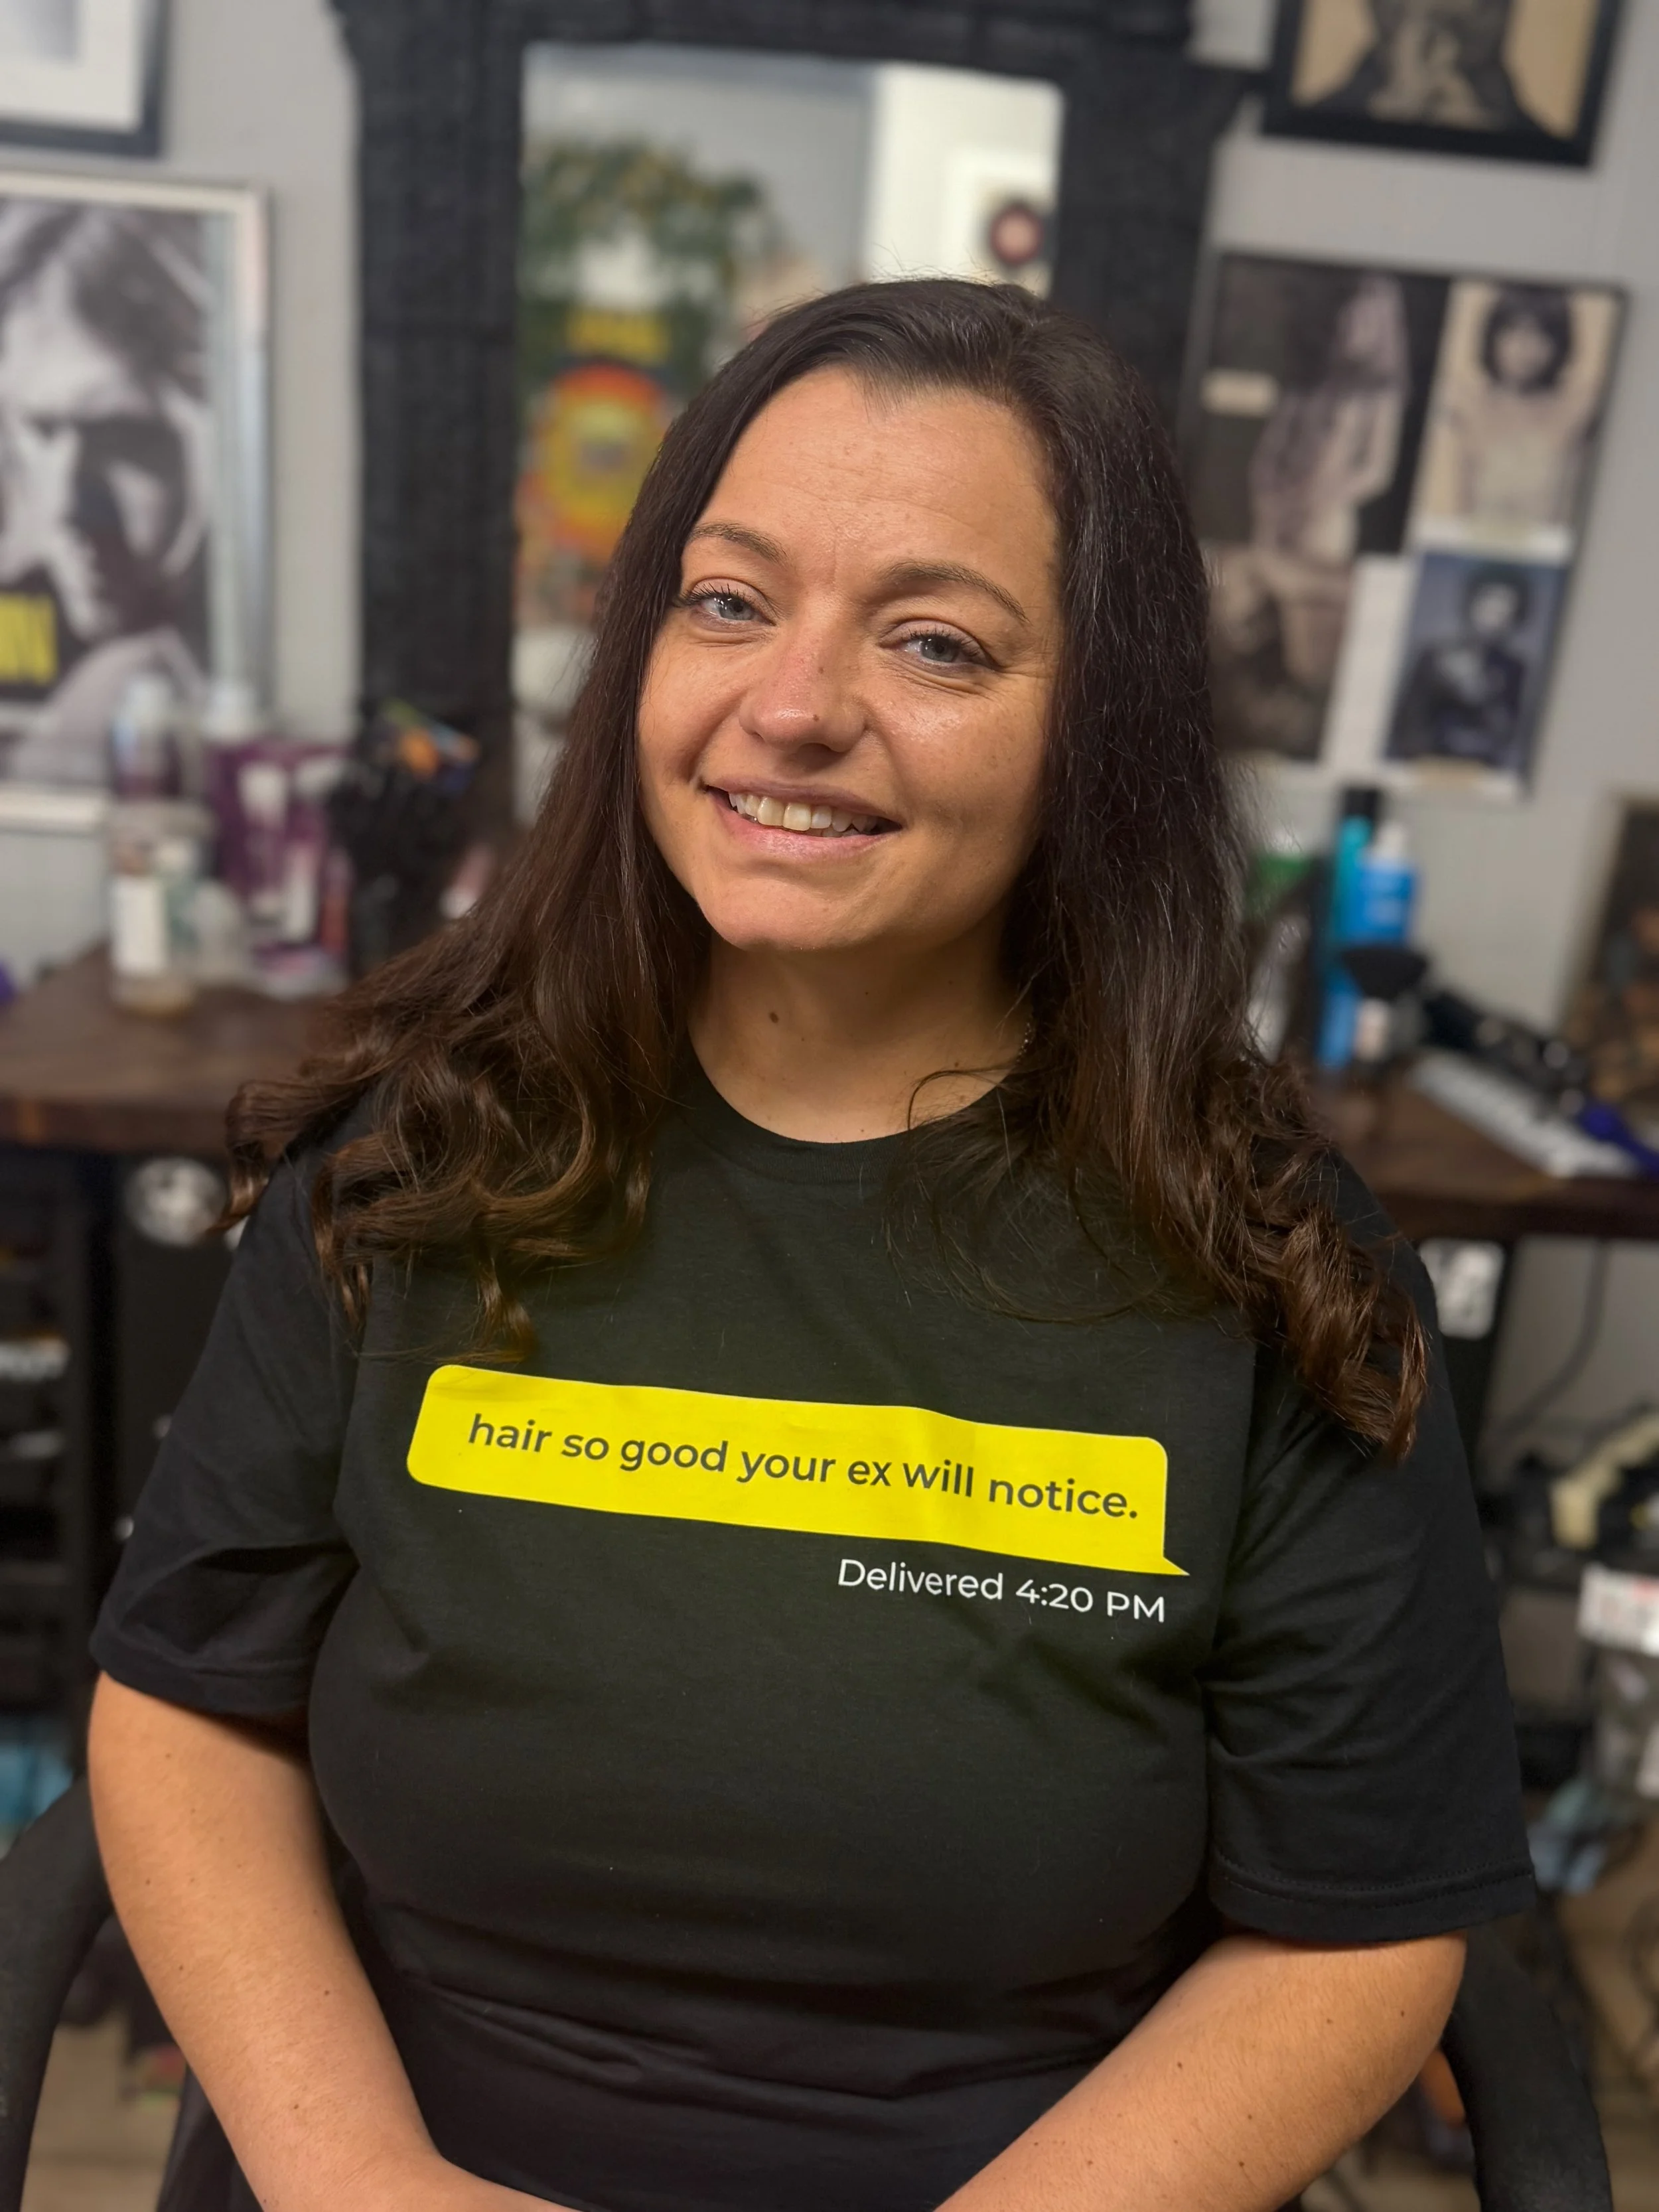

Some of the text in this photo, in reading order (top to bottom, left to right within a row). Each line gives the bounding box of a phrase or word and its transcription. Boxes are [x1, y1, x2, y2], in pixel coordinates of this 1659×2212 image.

[469, 1413, 1137, 1518] hair so good your ex will notice.
[837, 1558, 1165, 1623] Delivered 4:20 PM
